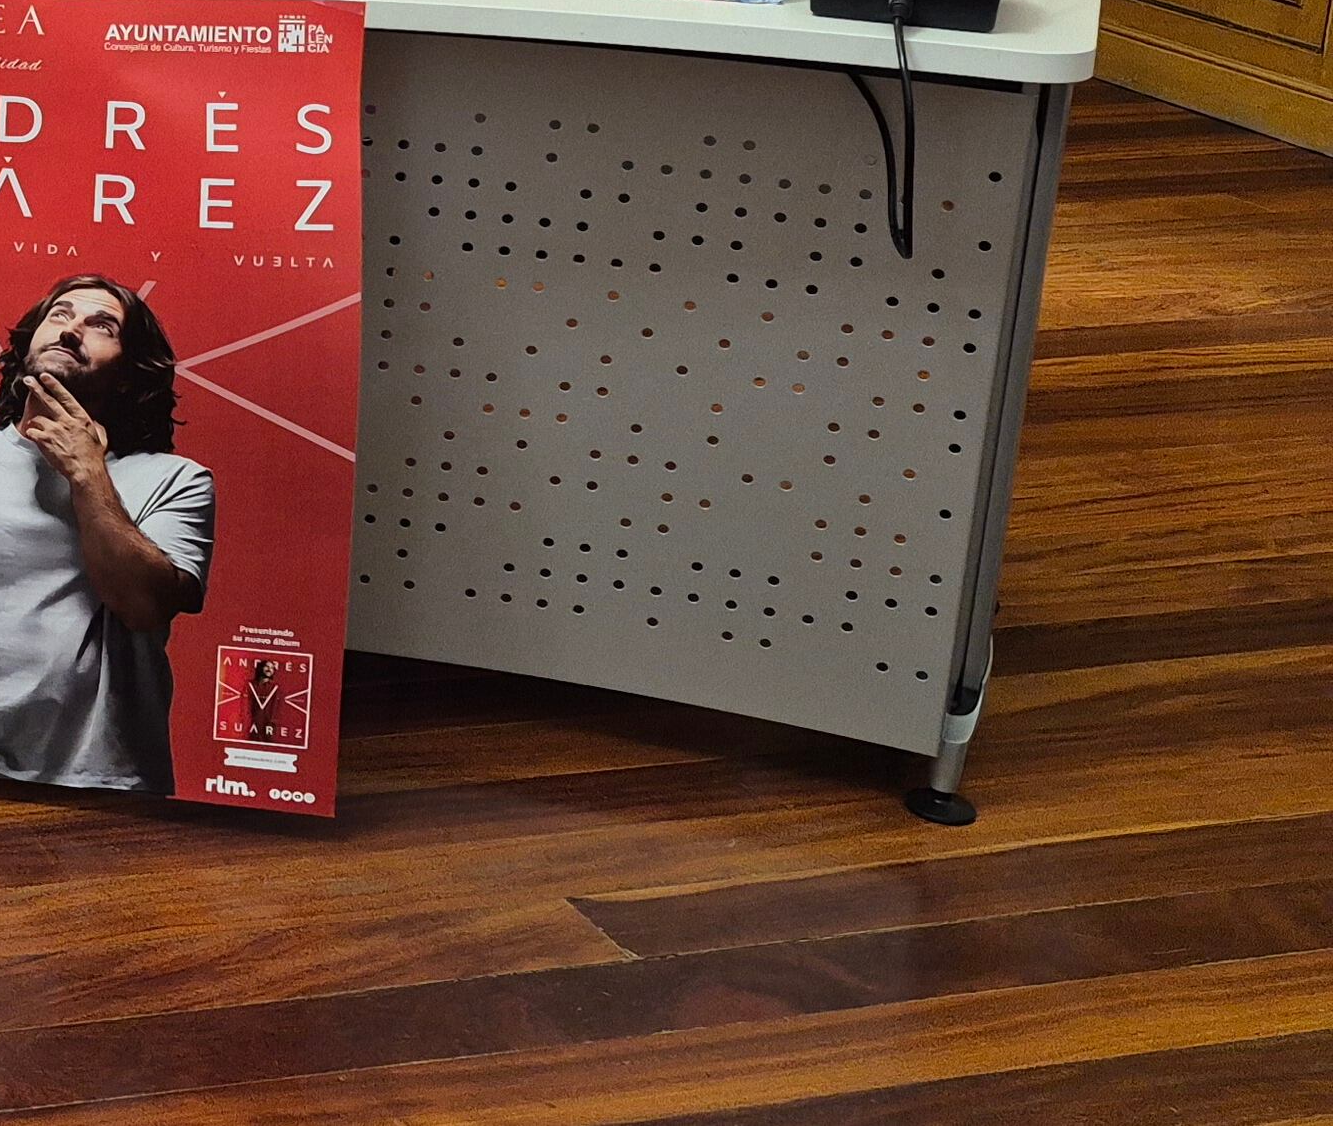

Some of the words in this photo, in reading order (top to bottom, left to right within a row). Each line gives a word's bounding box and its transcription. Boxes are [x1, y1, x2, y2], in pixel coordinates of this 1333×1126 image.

[104, 24, 272, 44] AYUNTAMIENTO
[308, 24, 325, 34] PA
[308, 34, 333, 44] LEN
[151, 42, 161, 51] de
[199, 44, 232, 53] Turismo
[233, 46, 240, 55] y
[241, 44, 271, 53] Fiestas
[307, 44, 329, 53] CIA
[14, 241, 78, 257] VIDA
[151, 251, 161, 263] Y
[234, 254, 333, 269] VUELTA
[239, 625, 294, 638] Presentando
[245, 637, 271, 645] nuevo
